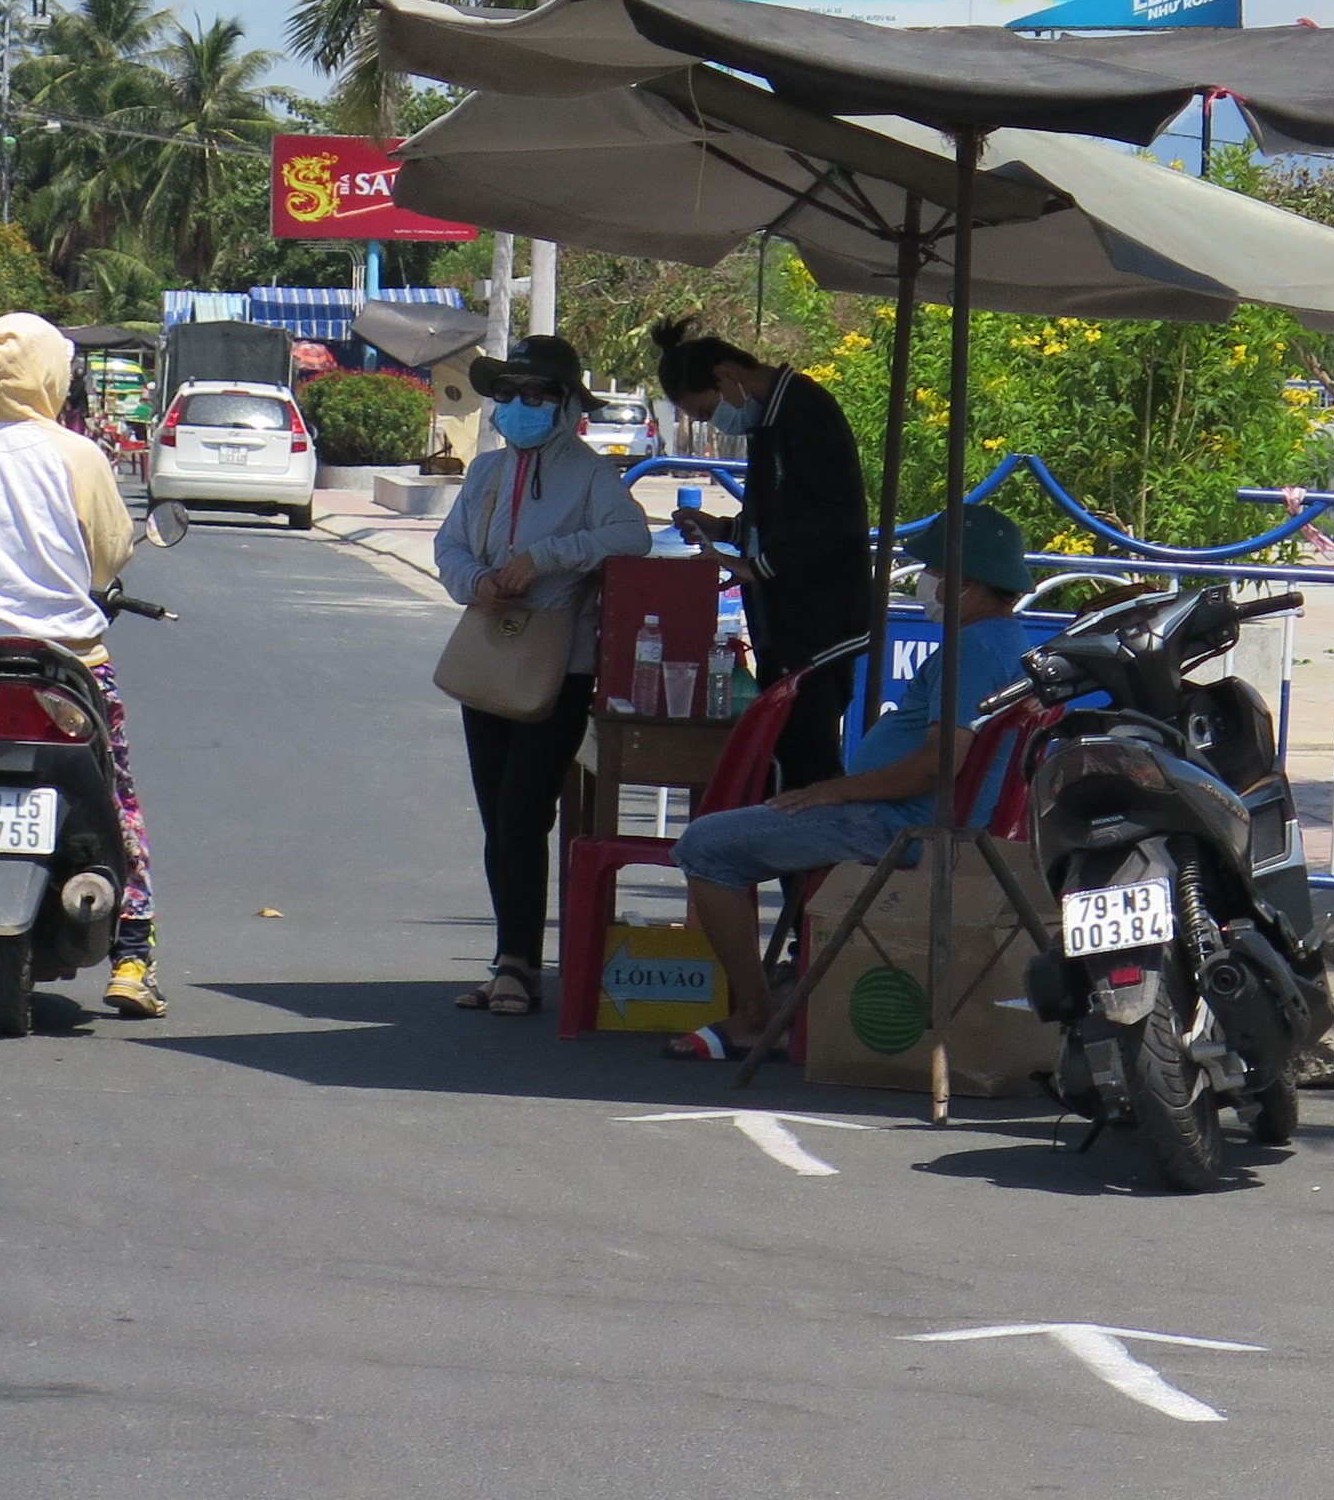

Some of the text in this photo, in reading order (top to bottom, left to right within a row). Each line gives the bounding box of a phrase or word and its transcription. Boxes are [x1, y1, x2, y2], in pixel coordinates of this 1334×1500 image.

[339, 173, 350, 195] BIA
[1091, 814, 1124, 826] HONDA
[1078, 887, 1152, 923] 79-N3
[1070, 912, 1163, 952] 003.84
